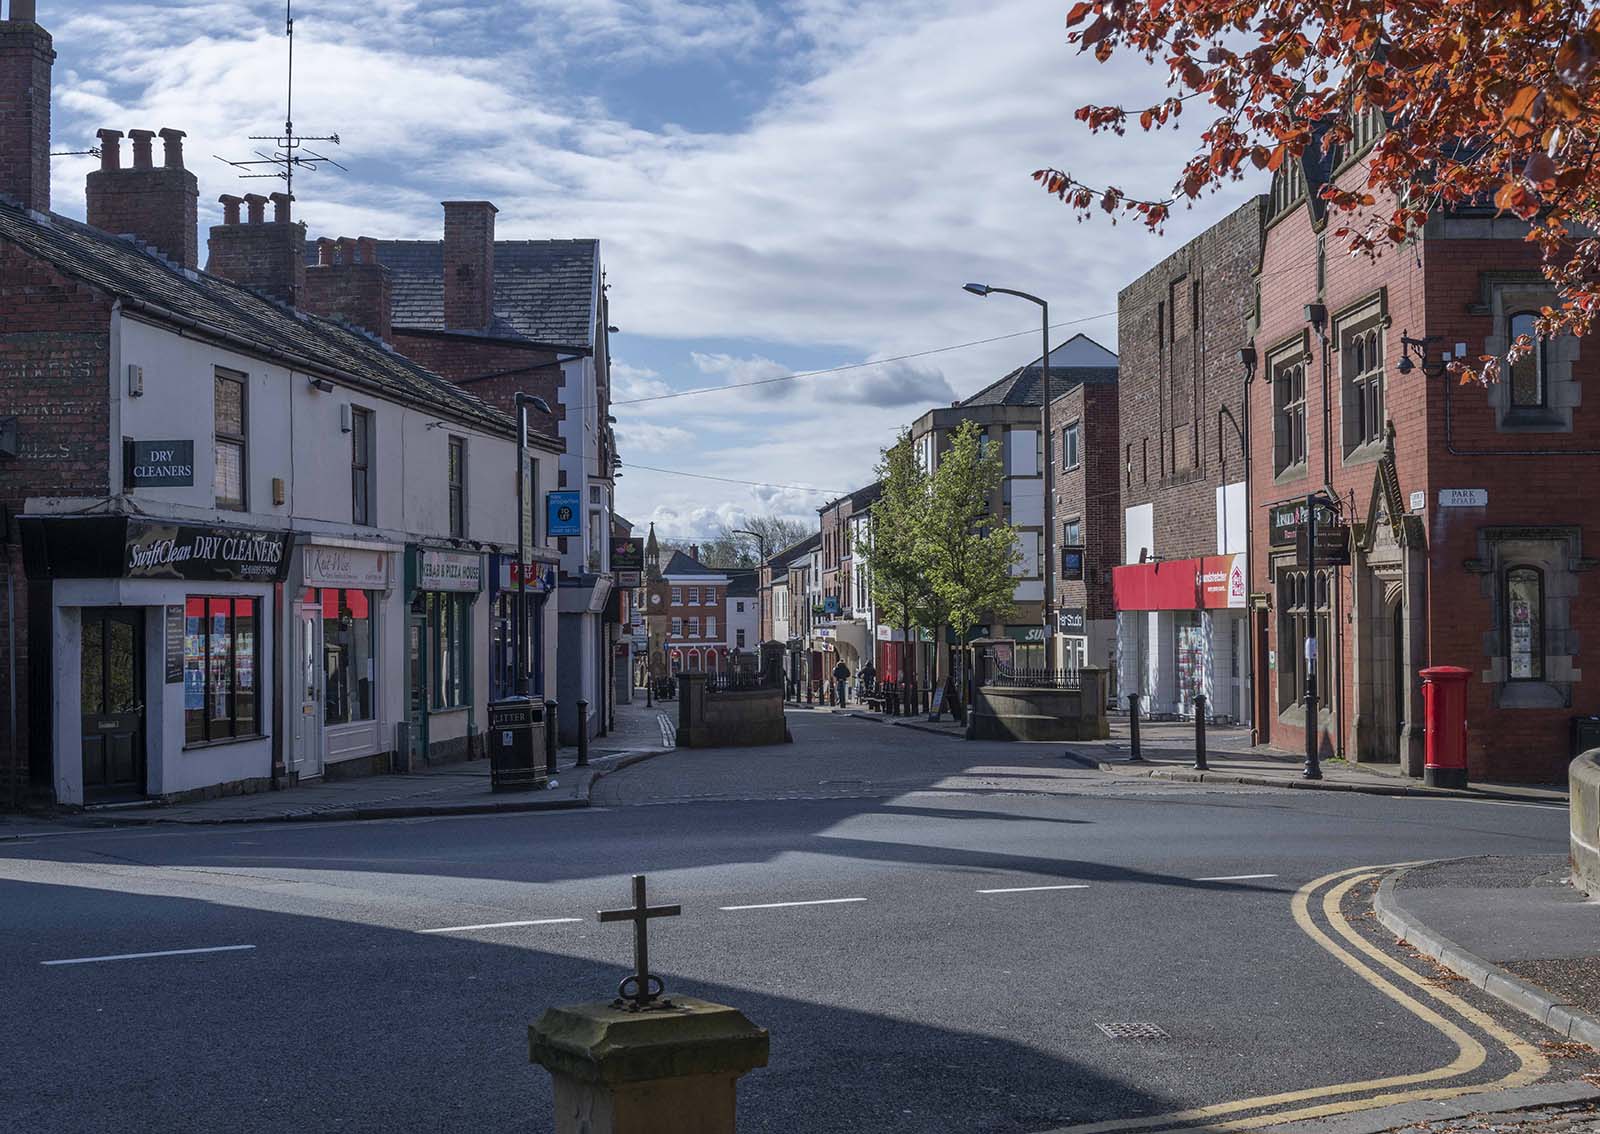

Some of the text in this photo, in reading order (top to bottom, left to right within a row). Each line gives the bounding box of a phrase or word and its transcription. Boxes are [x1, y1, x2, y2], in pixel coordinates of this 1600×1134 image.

[151, 450, 174, 462] DRY
[133, 465, 192, 478] CLEANERS
[1451, 490, 1474, 498] PARK
[129, 536, 283, 570] SwiftClean DRY CLEANERS
[446, 564, 460, 578] PIZZA
[462, 565, 480, 580] HOUSE
[495, 713, 526, 722] LITTER
